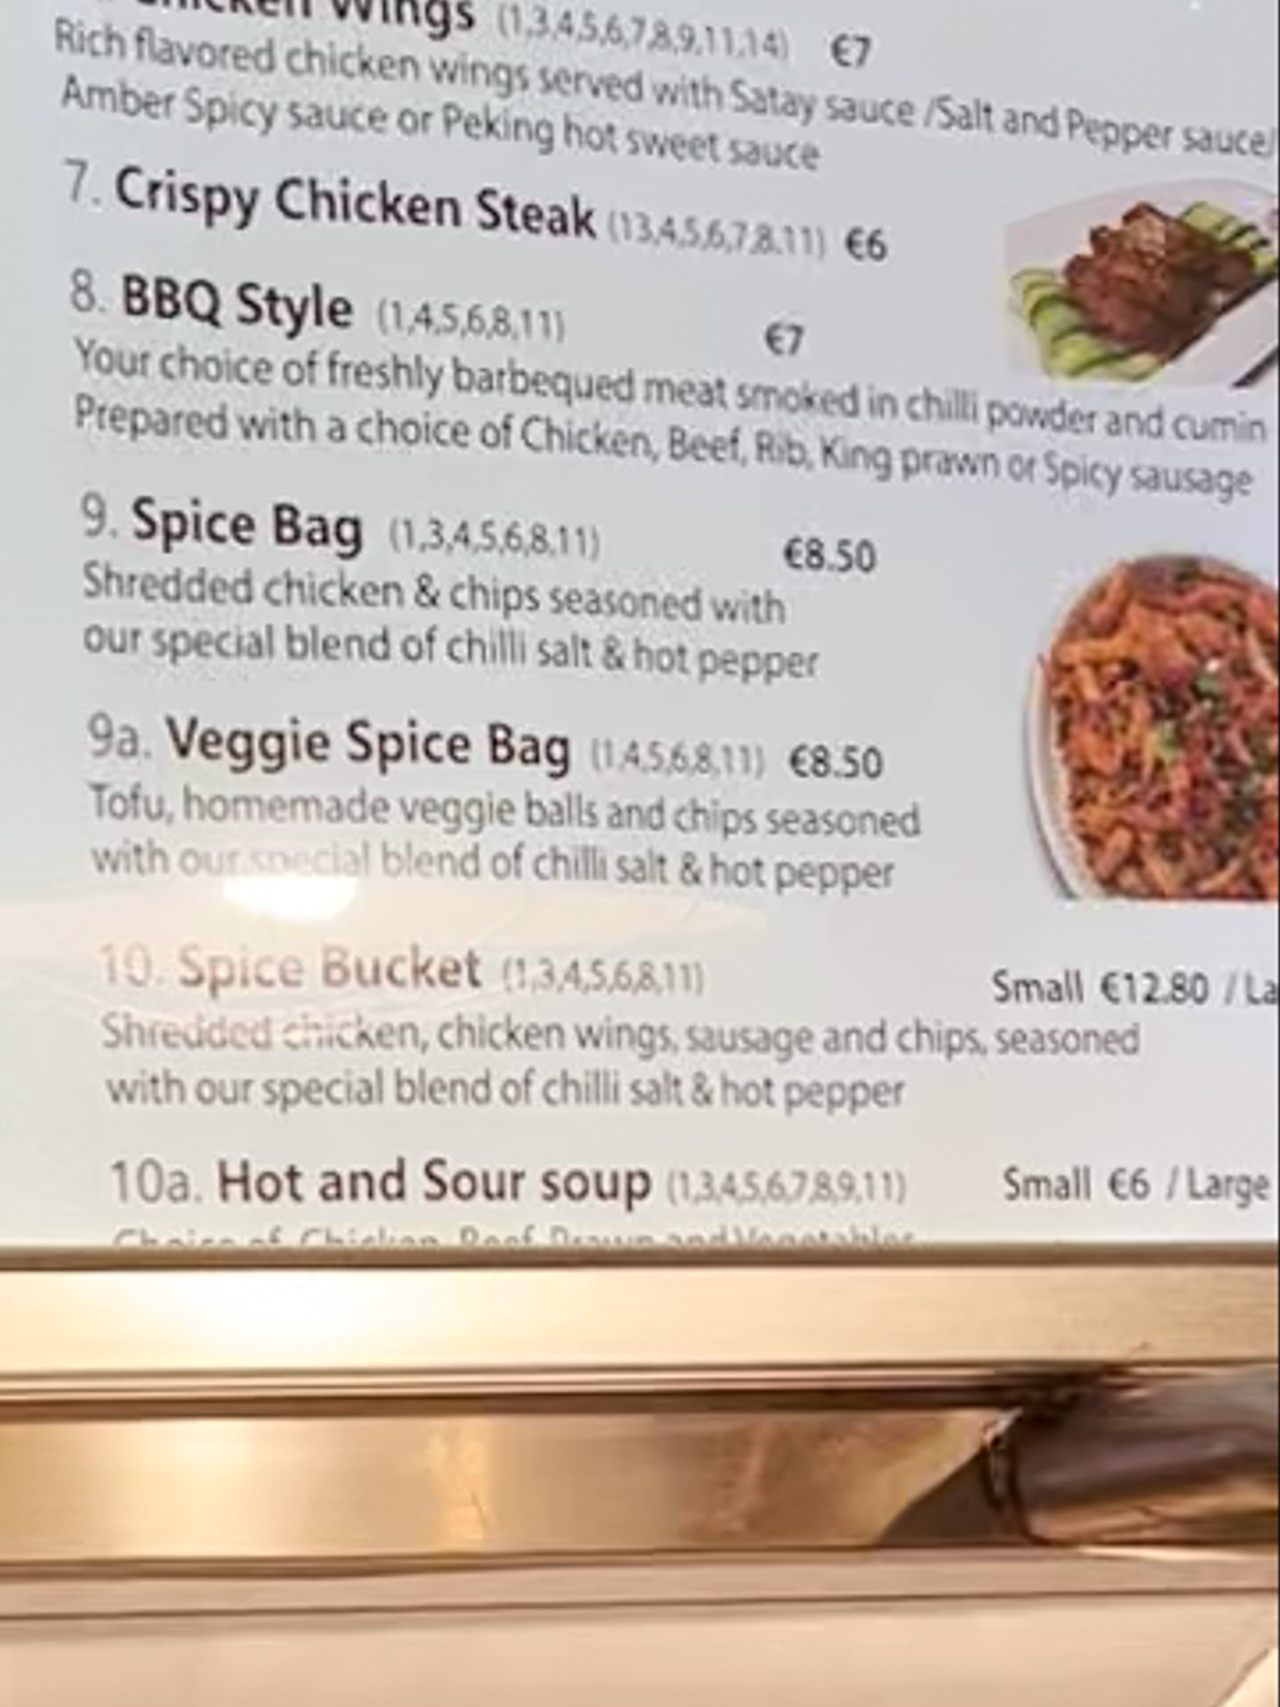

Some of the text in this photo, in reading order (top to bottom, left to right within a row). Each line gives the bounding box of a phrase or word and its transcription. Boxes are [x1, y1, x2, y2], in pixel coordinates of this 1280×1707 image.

[831, 35, 869, 66] €7
[65, 160, 886, 259] 7. Crispy Chicken Steak €6
[71, 270, 104, 310] 8.
[123, 274, 223, 332] BBQ
[236, 283, 352, 338] Style
[765, 324, 802, 354] €7
[82, 493, 116, 536] 9.
[132, 497, 254, 551] Spice
[273, 504, 362, 558] Bag
[784, 537, 876, 571] €8.50
[85, 619, 817, 682] our special blend of chilli salt & hot pepper
[89, 712, 882, 778] 9a. Veggie Spice Bag €8.50
[113, 1158, 651, 1211] 10a. Hot and Sour soup
[1005, 1167, 1269, 1207] Small €6 Large
